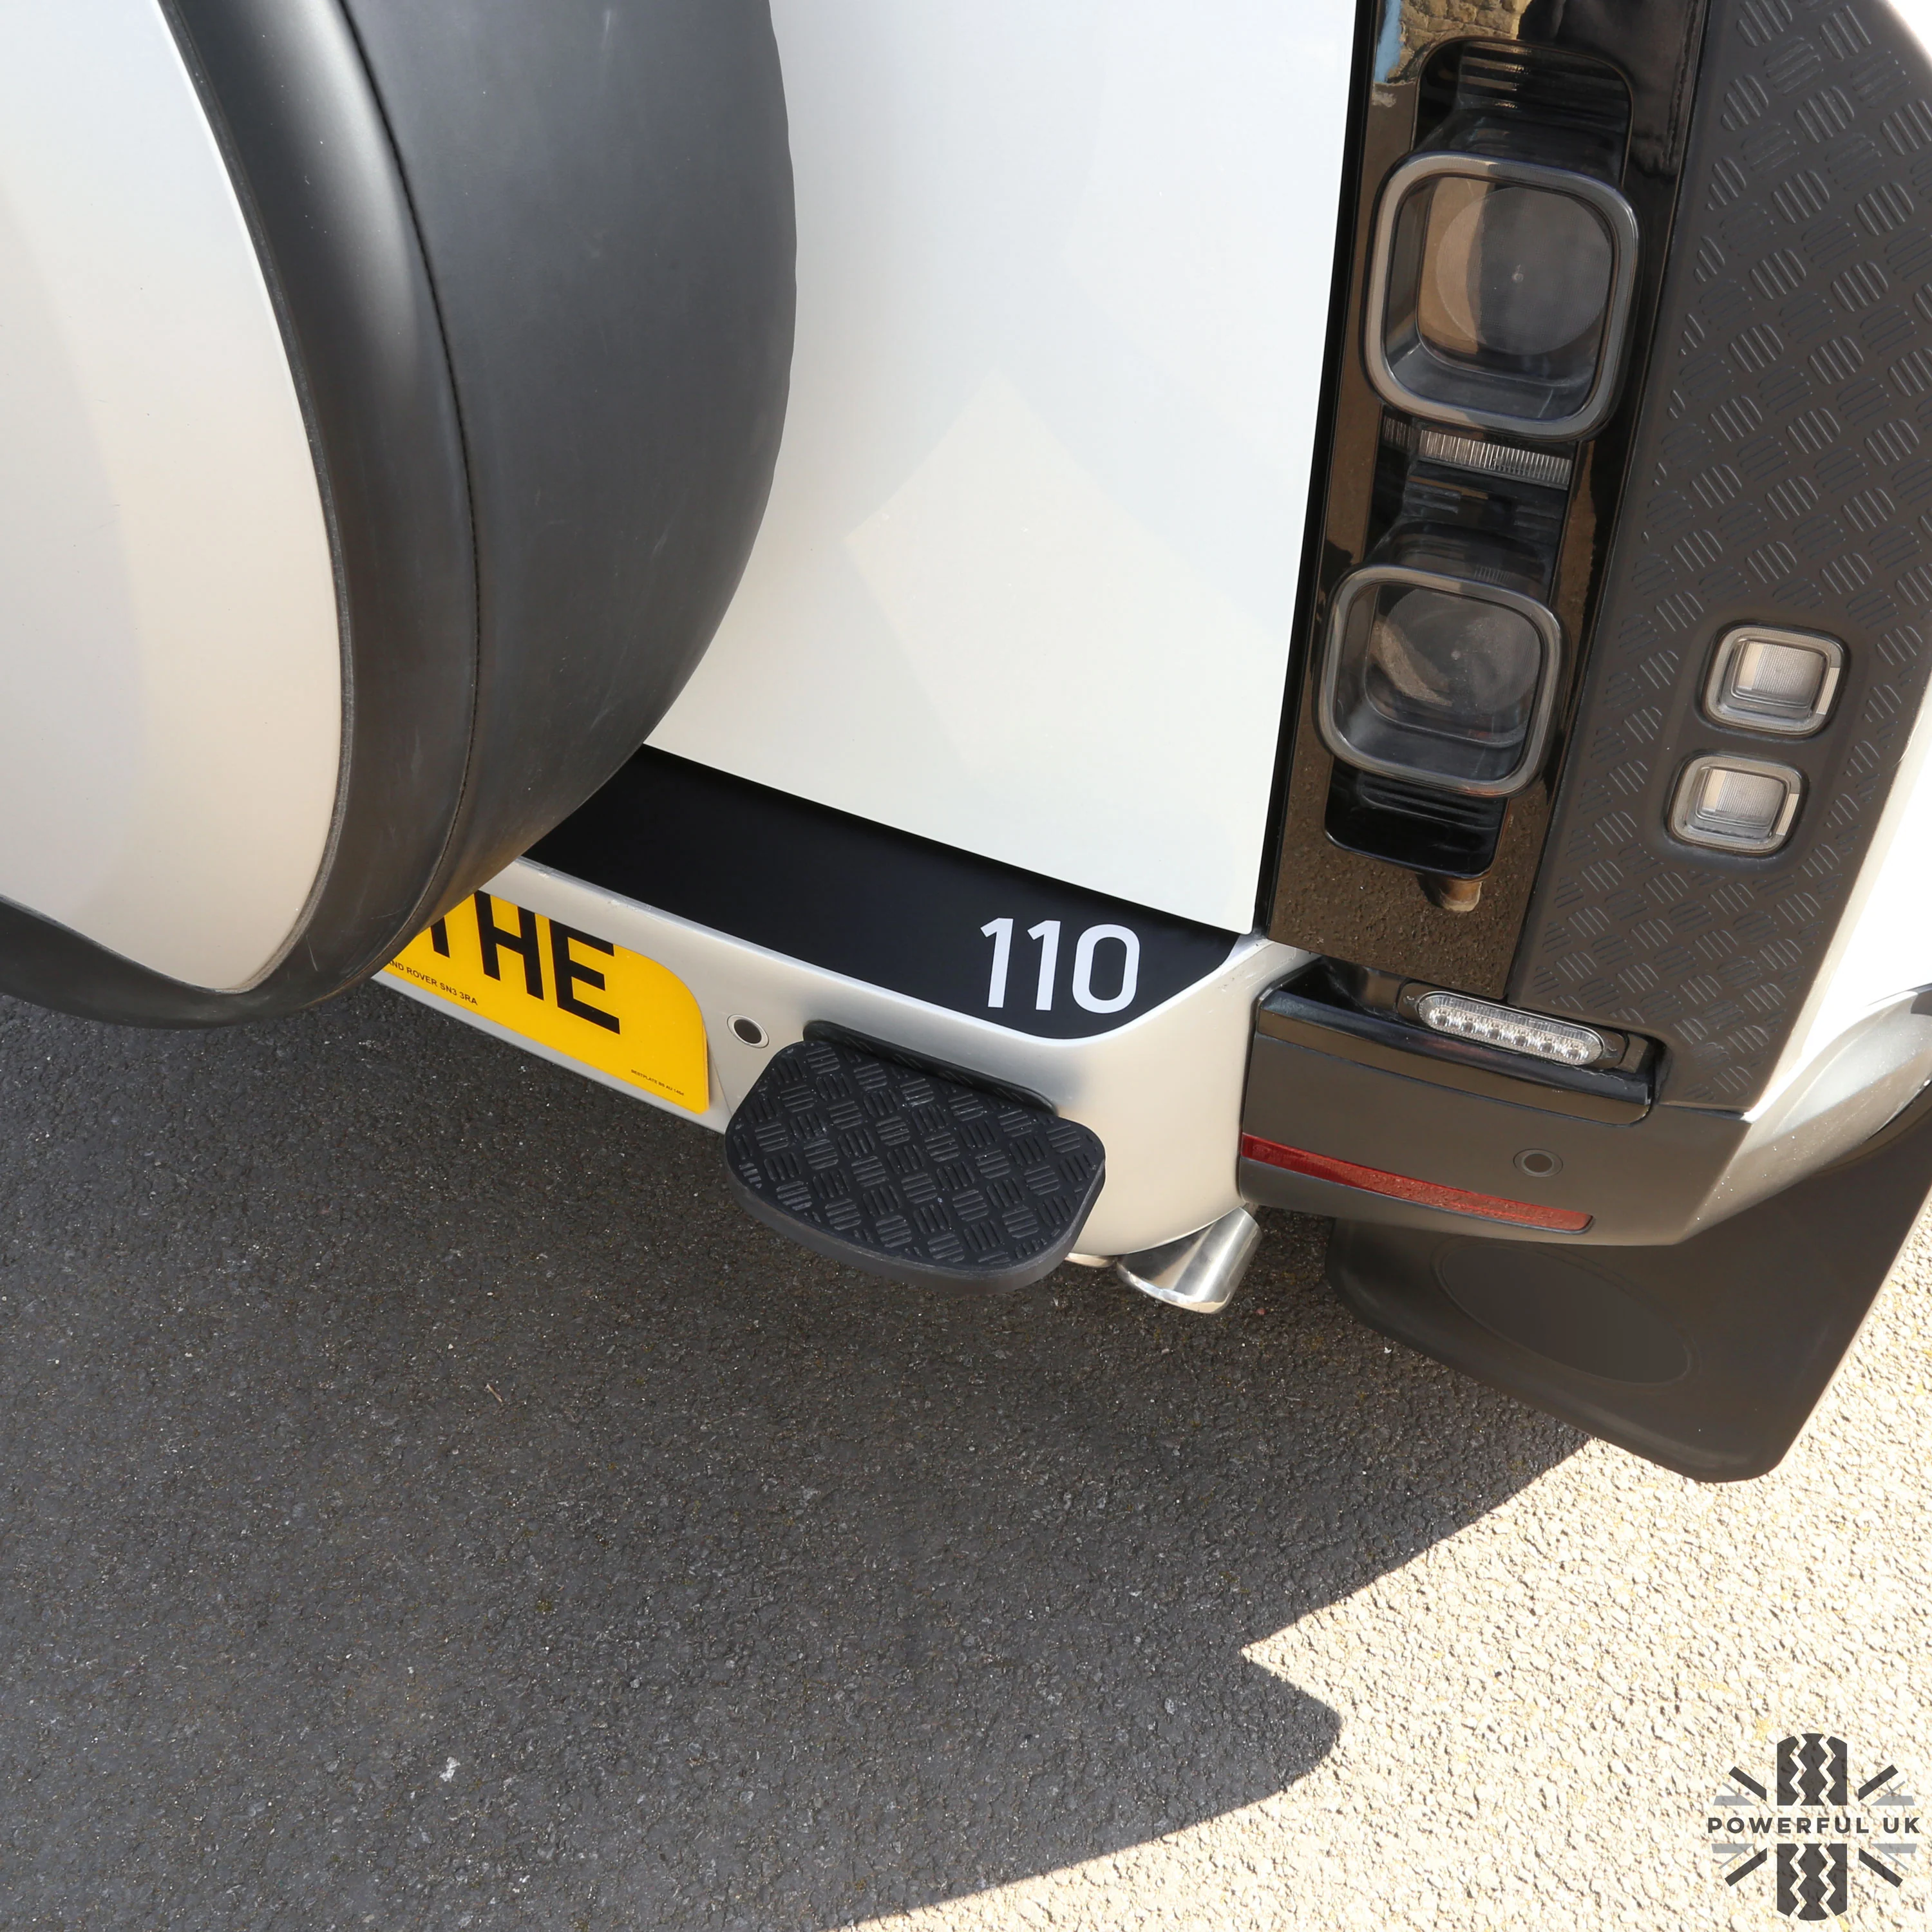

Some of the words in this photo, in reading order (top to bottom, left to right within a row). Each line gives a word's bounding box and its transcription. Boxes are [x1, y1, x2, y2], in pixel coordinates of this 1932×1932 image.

[406, 967, 438, 987] ROVER
[440, 982, 457, 996] SN3
[459, 991, 478, 1006] 3RA
[980, 917, 1141, 1014] 110
